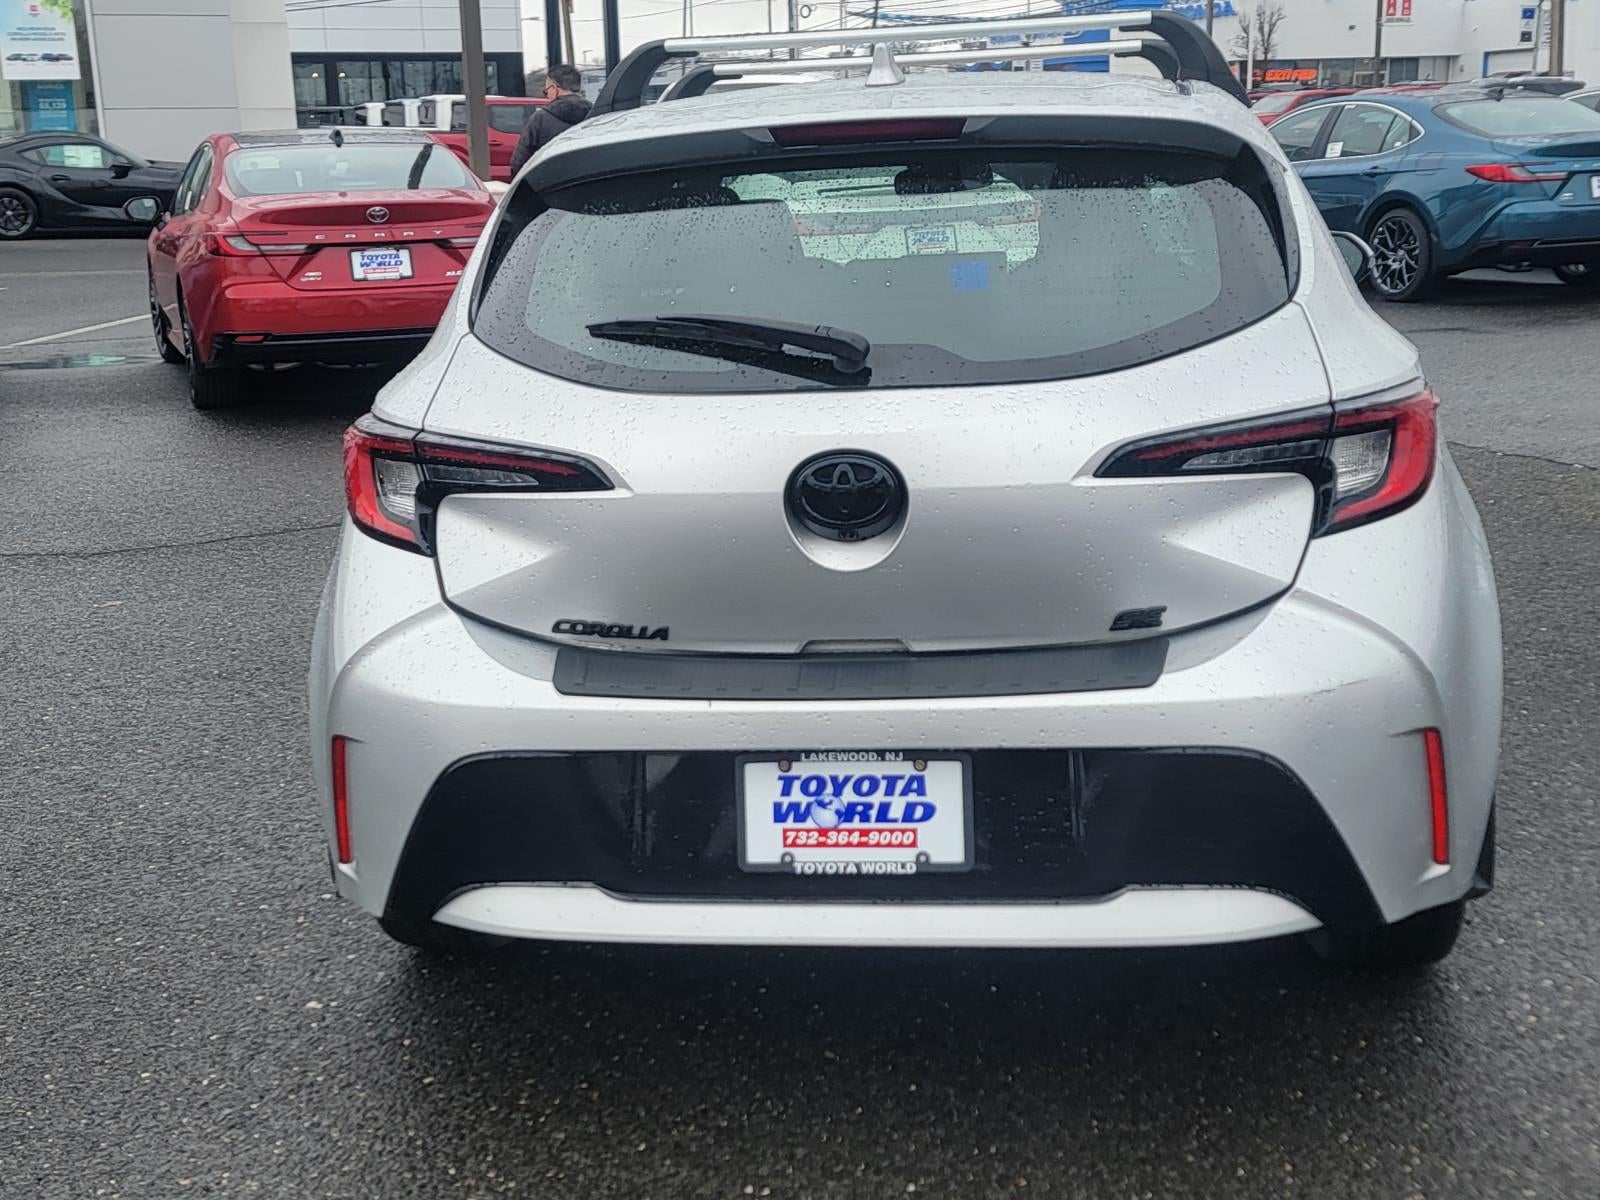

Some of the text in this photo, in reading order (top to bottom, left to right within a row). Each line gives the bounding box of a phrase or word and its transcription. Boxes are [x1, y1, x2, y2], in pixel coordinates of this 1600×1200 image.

[360, 253, 400, 261] TOYOTA
[552, 619, 669, 640] COROLLA
[885, 752, 904, 761] NJ
[777, 774, 927, 797] TOYOTA
[785, 831, 914, 845] 732-364-9000
[794, 861, 917, 875] TOYOTA WORLD
